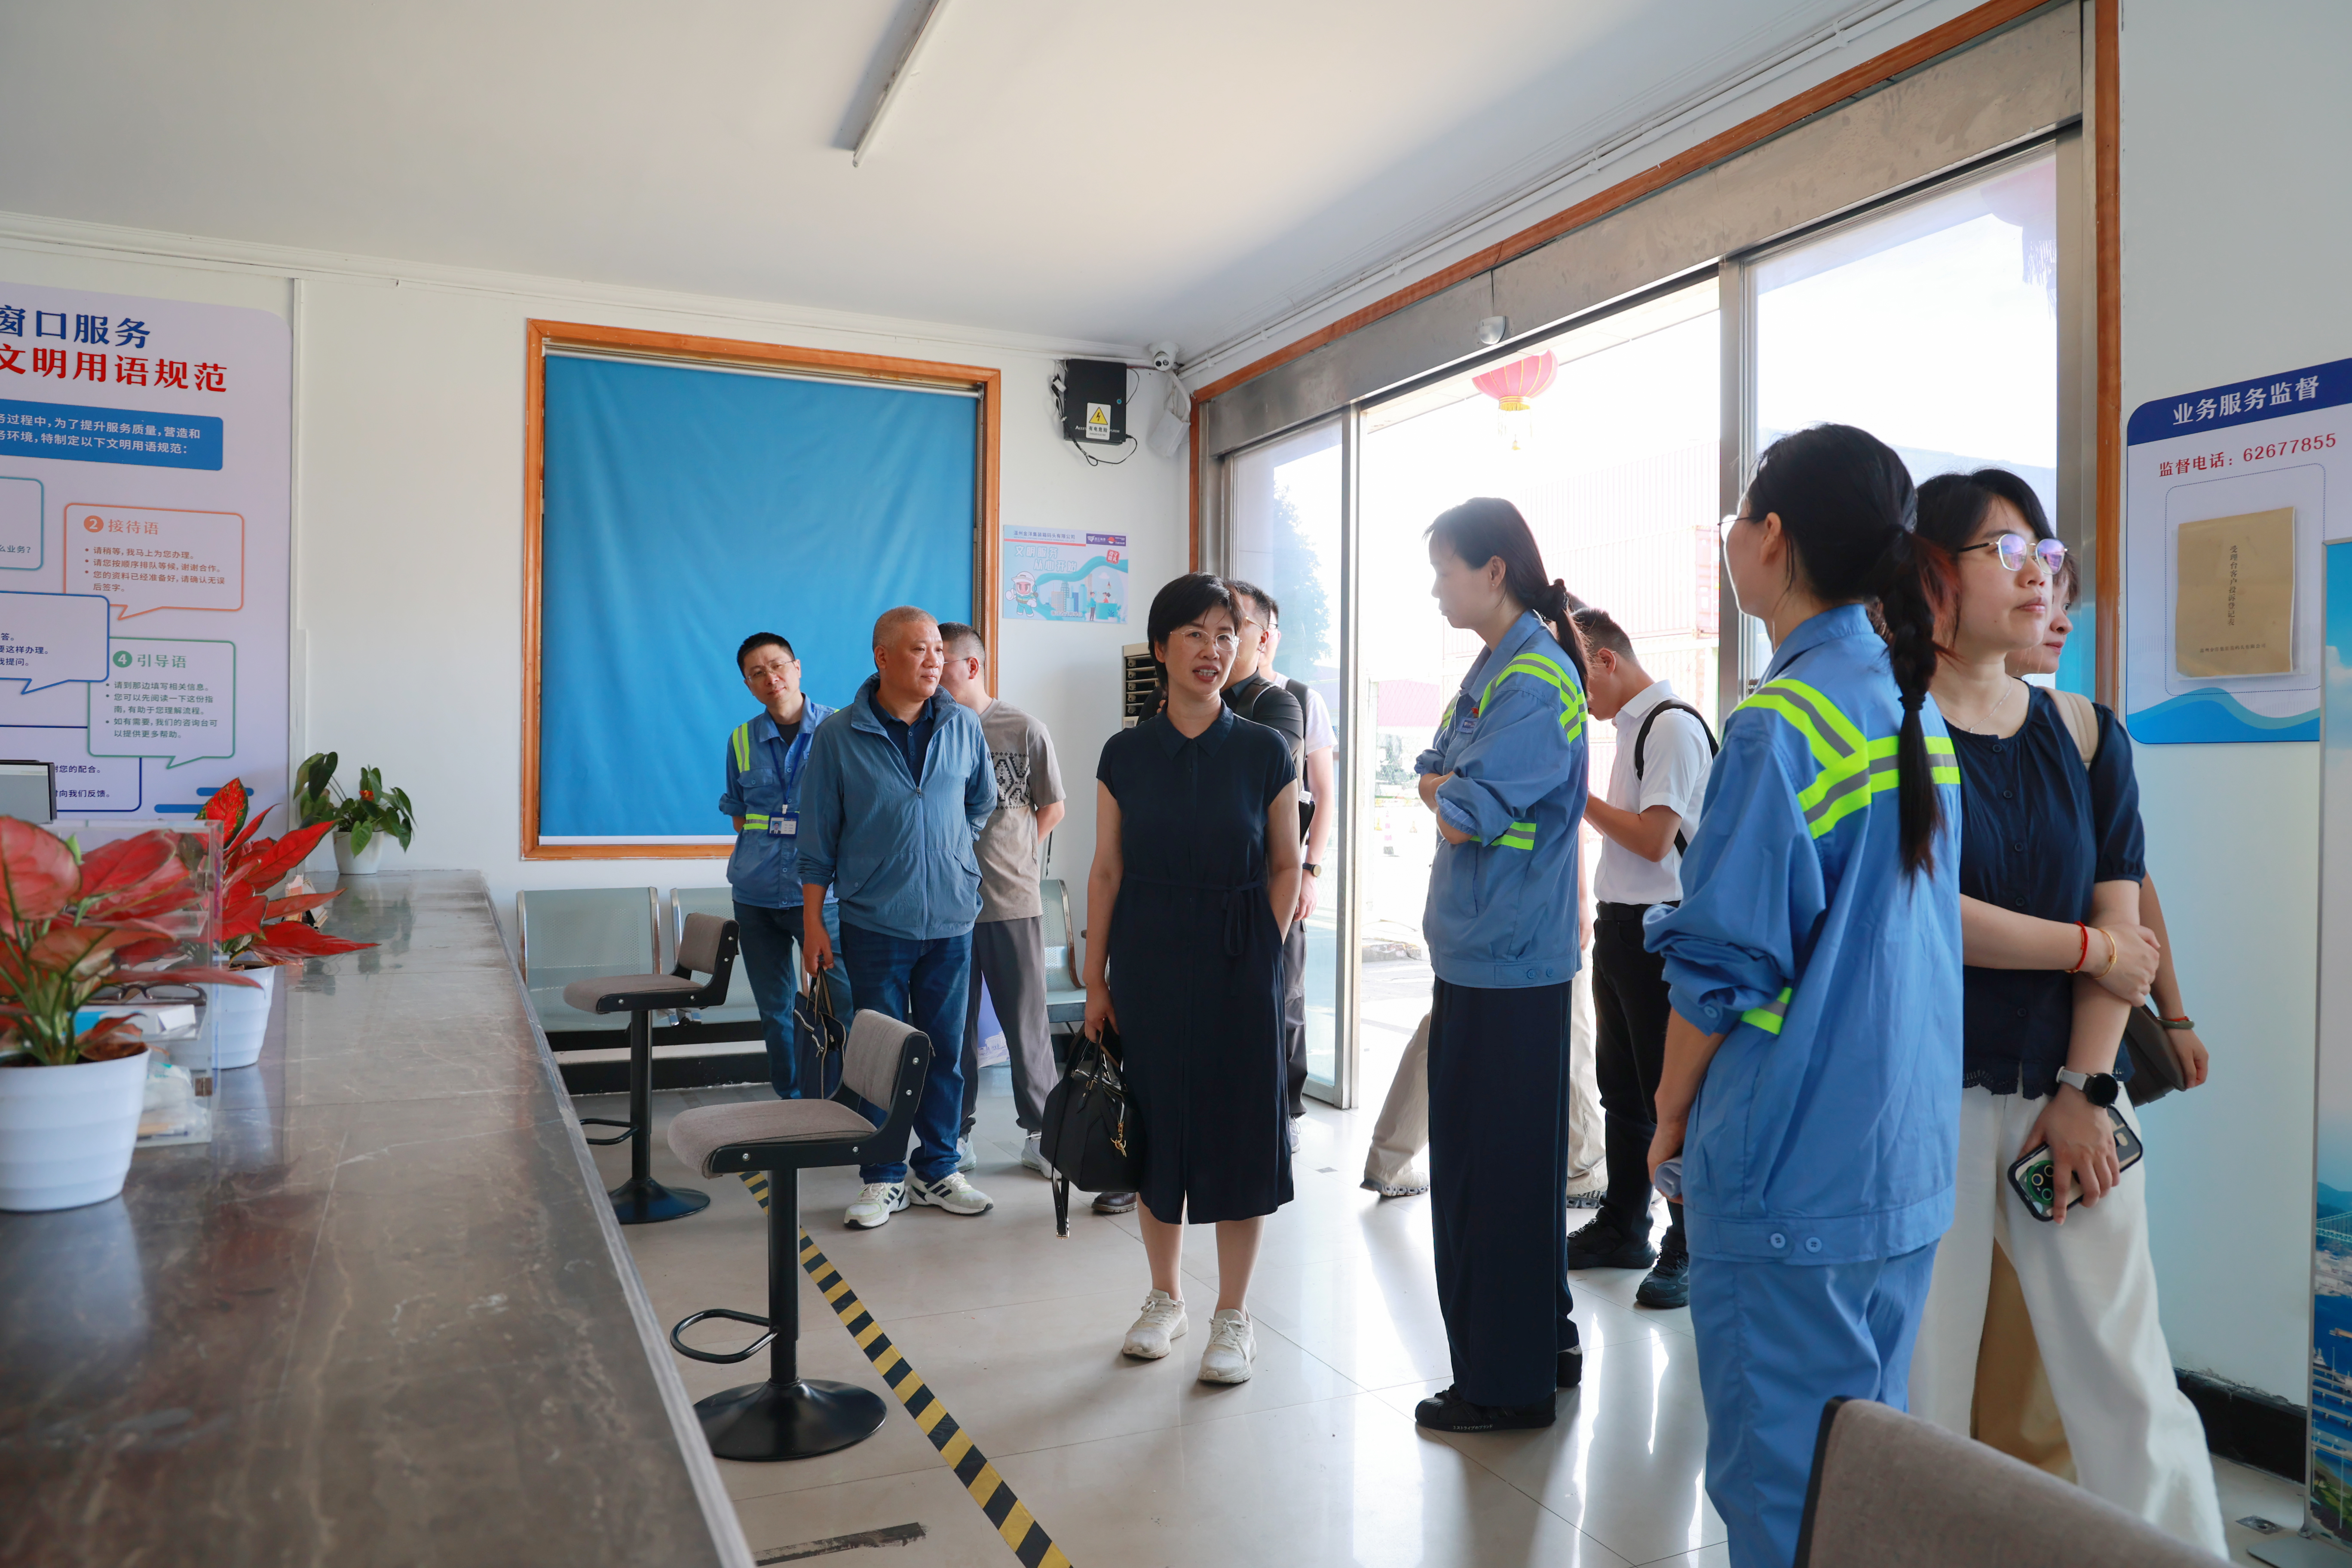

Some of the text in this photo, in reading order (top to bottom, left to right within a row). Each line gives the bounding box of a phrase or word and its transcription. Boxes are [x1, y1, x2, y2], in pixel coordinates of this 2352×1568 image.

[0, 305, 150, 348] 窗口服务
[0, 343, 227, 392] 文明用语规范
[2173, 376, 2319, 425] 业务服务监督
[108, 519, 159, 535] 接待语
[1014, 530, 1075, 539] 温州金洋集装箱码头有限公司
[93, 546, 193, 559] 请稍等,我马上为您办理。
[1015, 545, 1058, 559] 文明服务
[93, 558, 220, 573] 请您按顺序排队等候,谢谢合作。
[1033, 559, 1077, 572] 从心开始
[93, 571, 225, 584] 您的资料已经准备好,请确认无误
[93, 583, 125, 592] 后签字。
[137, 654, 187, 668] 引导语
[114, 681, 208, 691] 请到那边填写相关信息。
[114, 693, 213, 703] 您可以先阅读一下这份指
[114, 705, 204, 715] 南,有助于您理解流程。
[114, 718, 217, 727] 如有需要,我们的咨询台可
[114, 730, 181, 738] 以提供更多帮助。
[56, 790, 110, 798] 向我们反馈。
